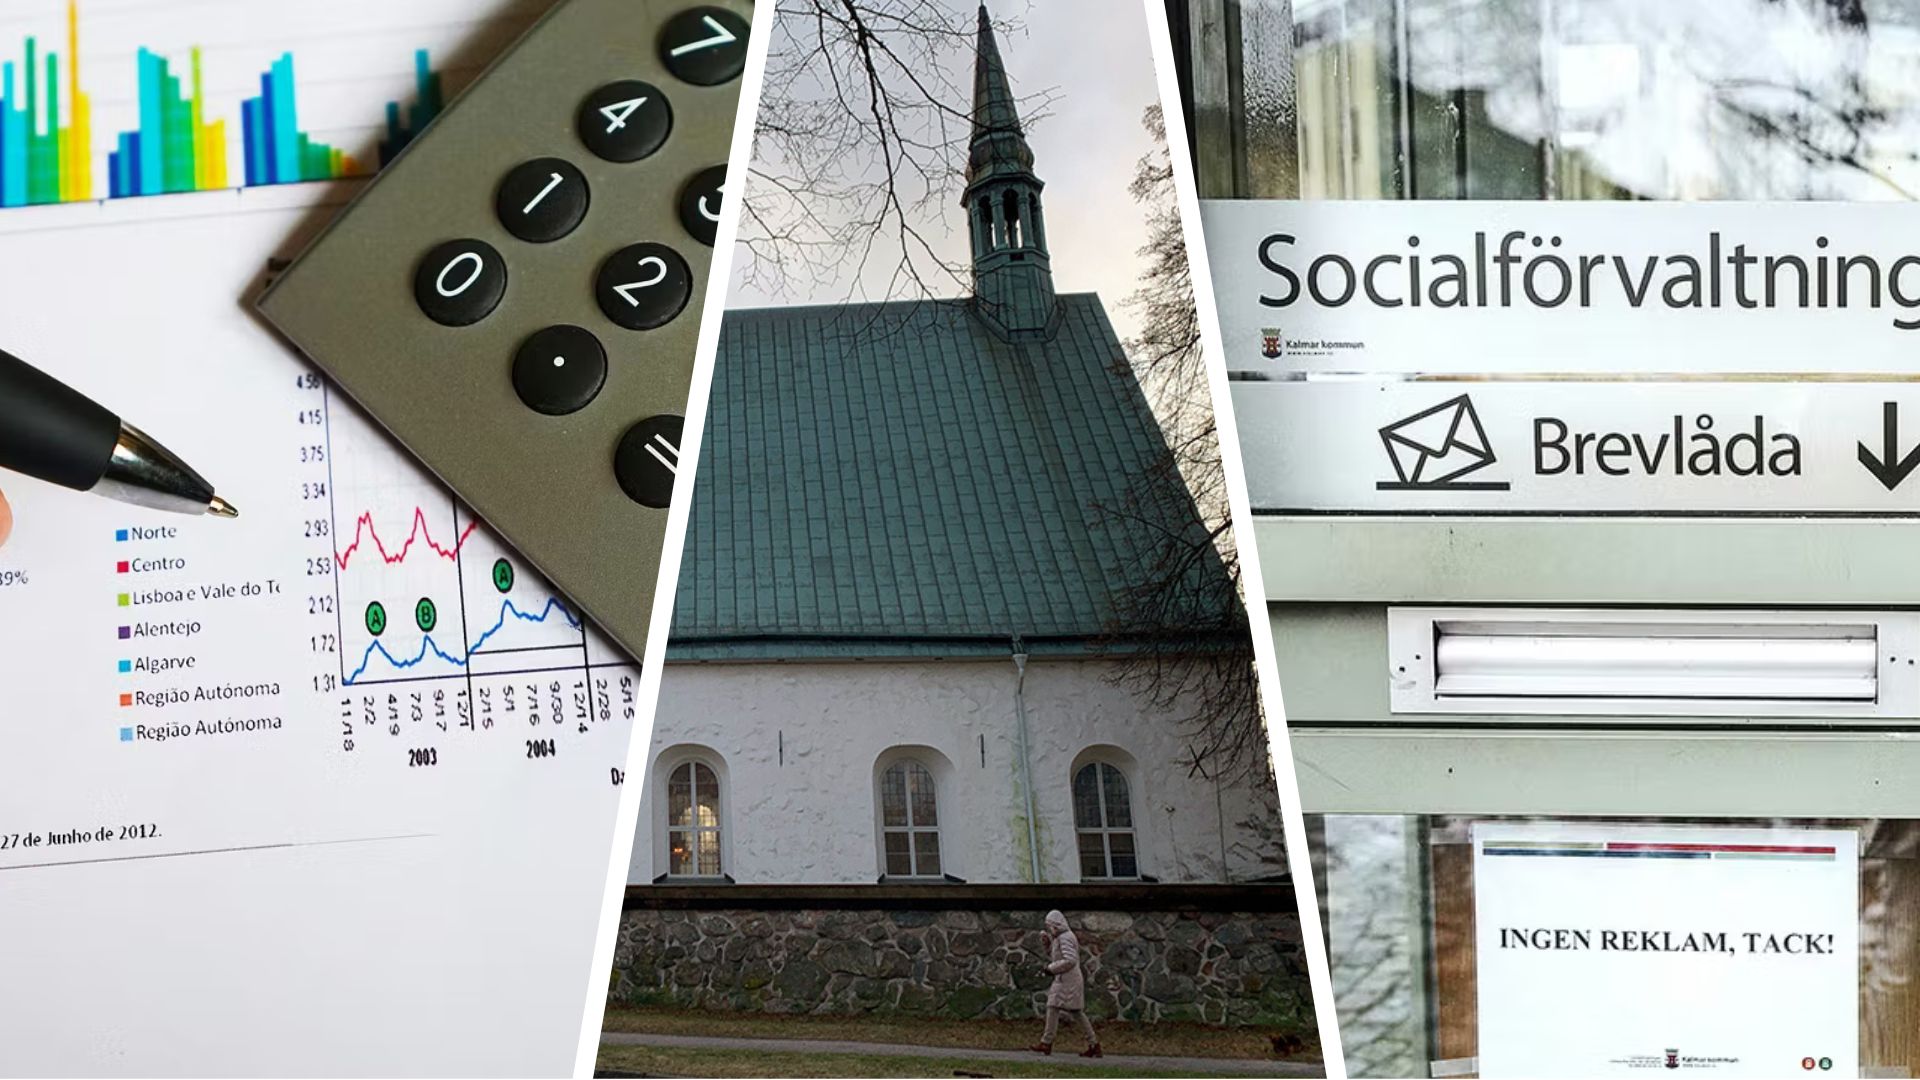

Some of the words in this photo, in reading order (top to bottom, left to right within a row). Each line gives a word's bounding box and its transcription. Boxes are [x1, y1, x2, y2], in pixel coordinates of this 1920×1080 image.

[670, 15, 737, 56] 7
[599, 97, 648, 134] 4
[522, 172, 564, 214] 1
[436, 252, 484, 297] 0
[613, 256, 668, 307] 2
[1533, 415, 1802, 477] Brevlåda
[131, 525, 177, 540] Norte
[131, 557, 186, 573] Centro
[133, 588, 184, 605] Lisboa
[186, 588, 196, 601] e
[200, 582, 236, 600] Vale
[241, 581, 262, 597] do
[133, 620, 202, 637] Alentejo
[134, 656, 196, 674] Algarve
[135, 686, 190, 708] Região
[194, 682, 281, 701] Autónoma
[136, 720, 191, 742] Região
[195, 716, 283, 736] Autónoma
[408, 746, 438, 768] 2003
[526, 738, 556, 760] 2004
[0, 834, 19, 850] 27
[22, 832, 42, 848] de
[46, 829, 92, 847] Junho
[95, 827, 114, 842] de
[119, 823, 163, 841] 2012.
[1499, 927, 1592, 951] INGEN
[1600, 929, 1736, 957] REKLAM,
[1742, 932, 1835, 955] TACK!
